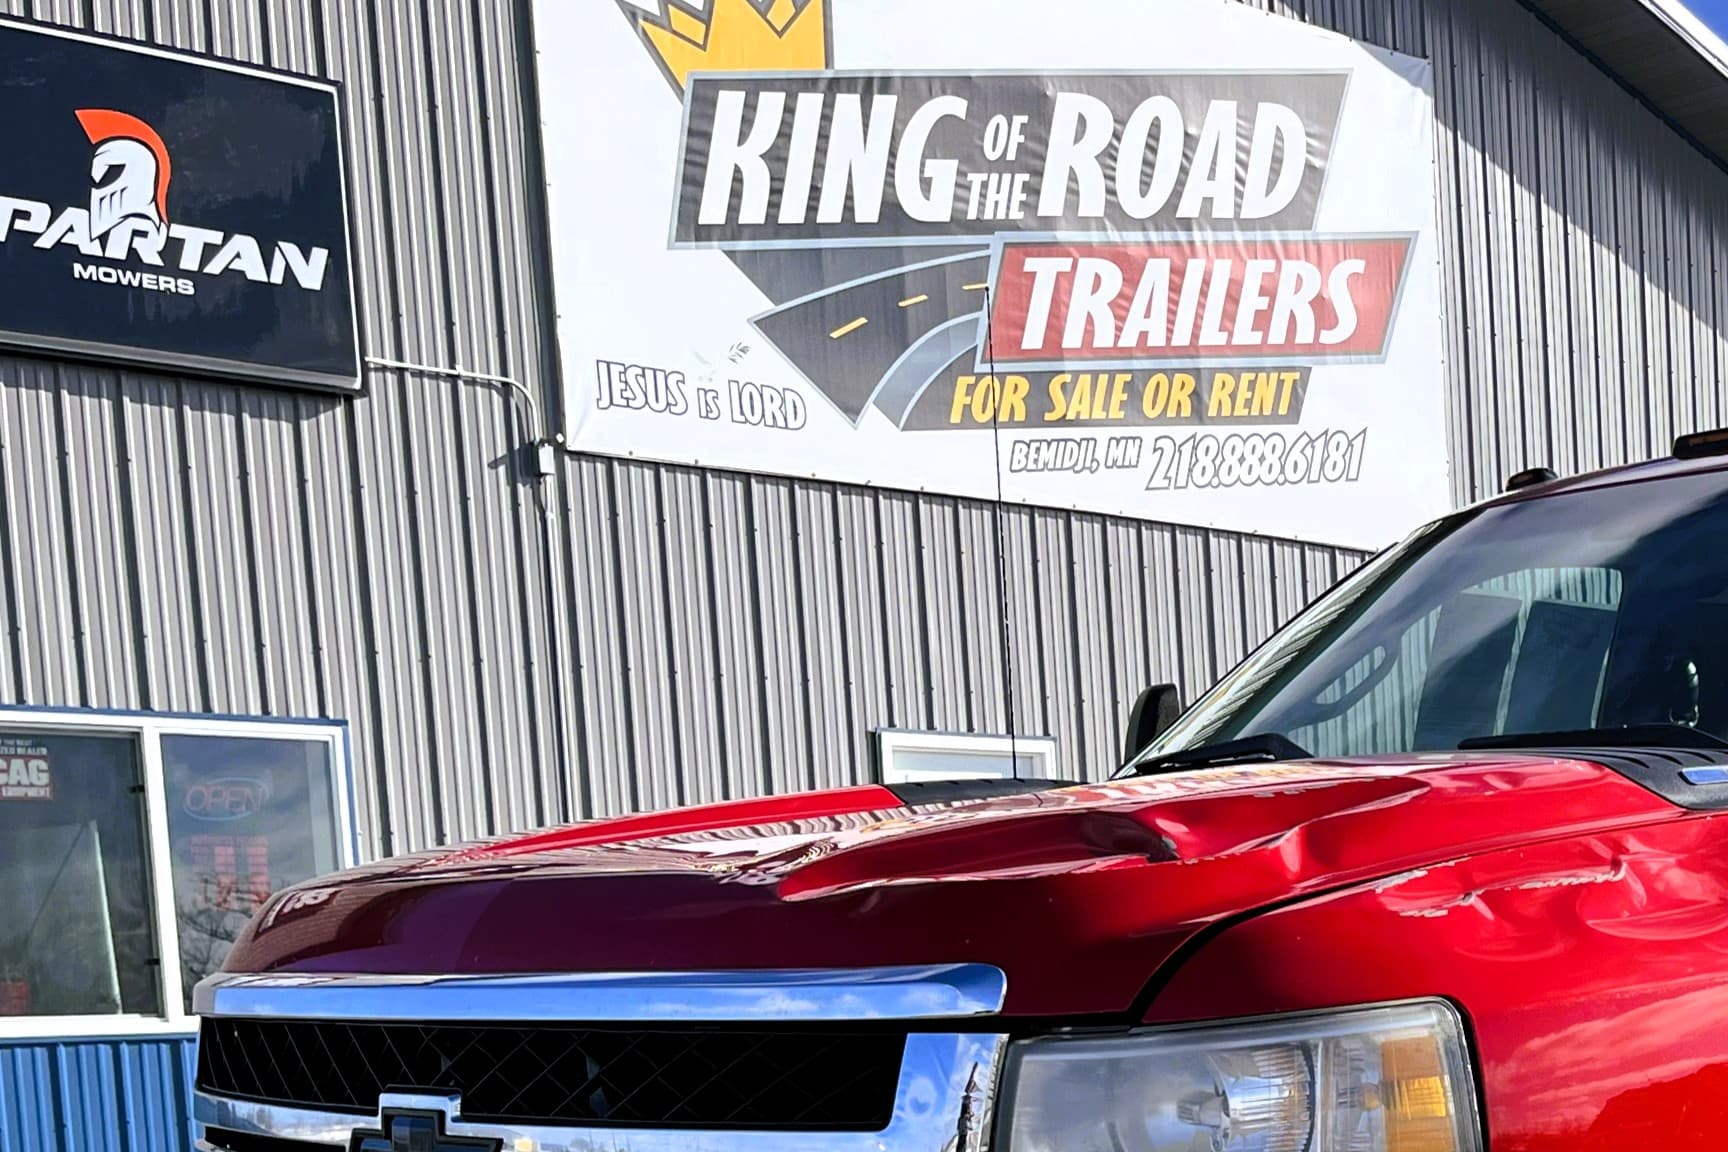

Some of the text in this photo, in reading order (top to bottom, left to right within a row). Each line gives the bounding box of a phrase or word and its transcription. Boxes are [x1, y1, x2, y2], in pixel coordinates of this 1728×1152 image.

[697, 89, 1309, 225] KING OF THE ROAD
[73, 262, 195, 296] MOWERS
[1020, 256, 1365, 350] TRAILERS
[596, 359, 689, 416] JESUS
[728, 379, 807, 431] LORD
[949, 372, 1300, 425] FOR SALE OR RENT
[1009, 426, 1369, 491] BEMIDJI, MN 218.888.6181
[187, 784, 262, 812] OPEN
